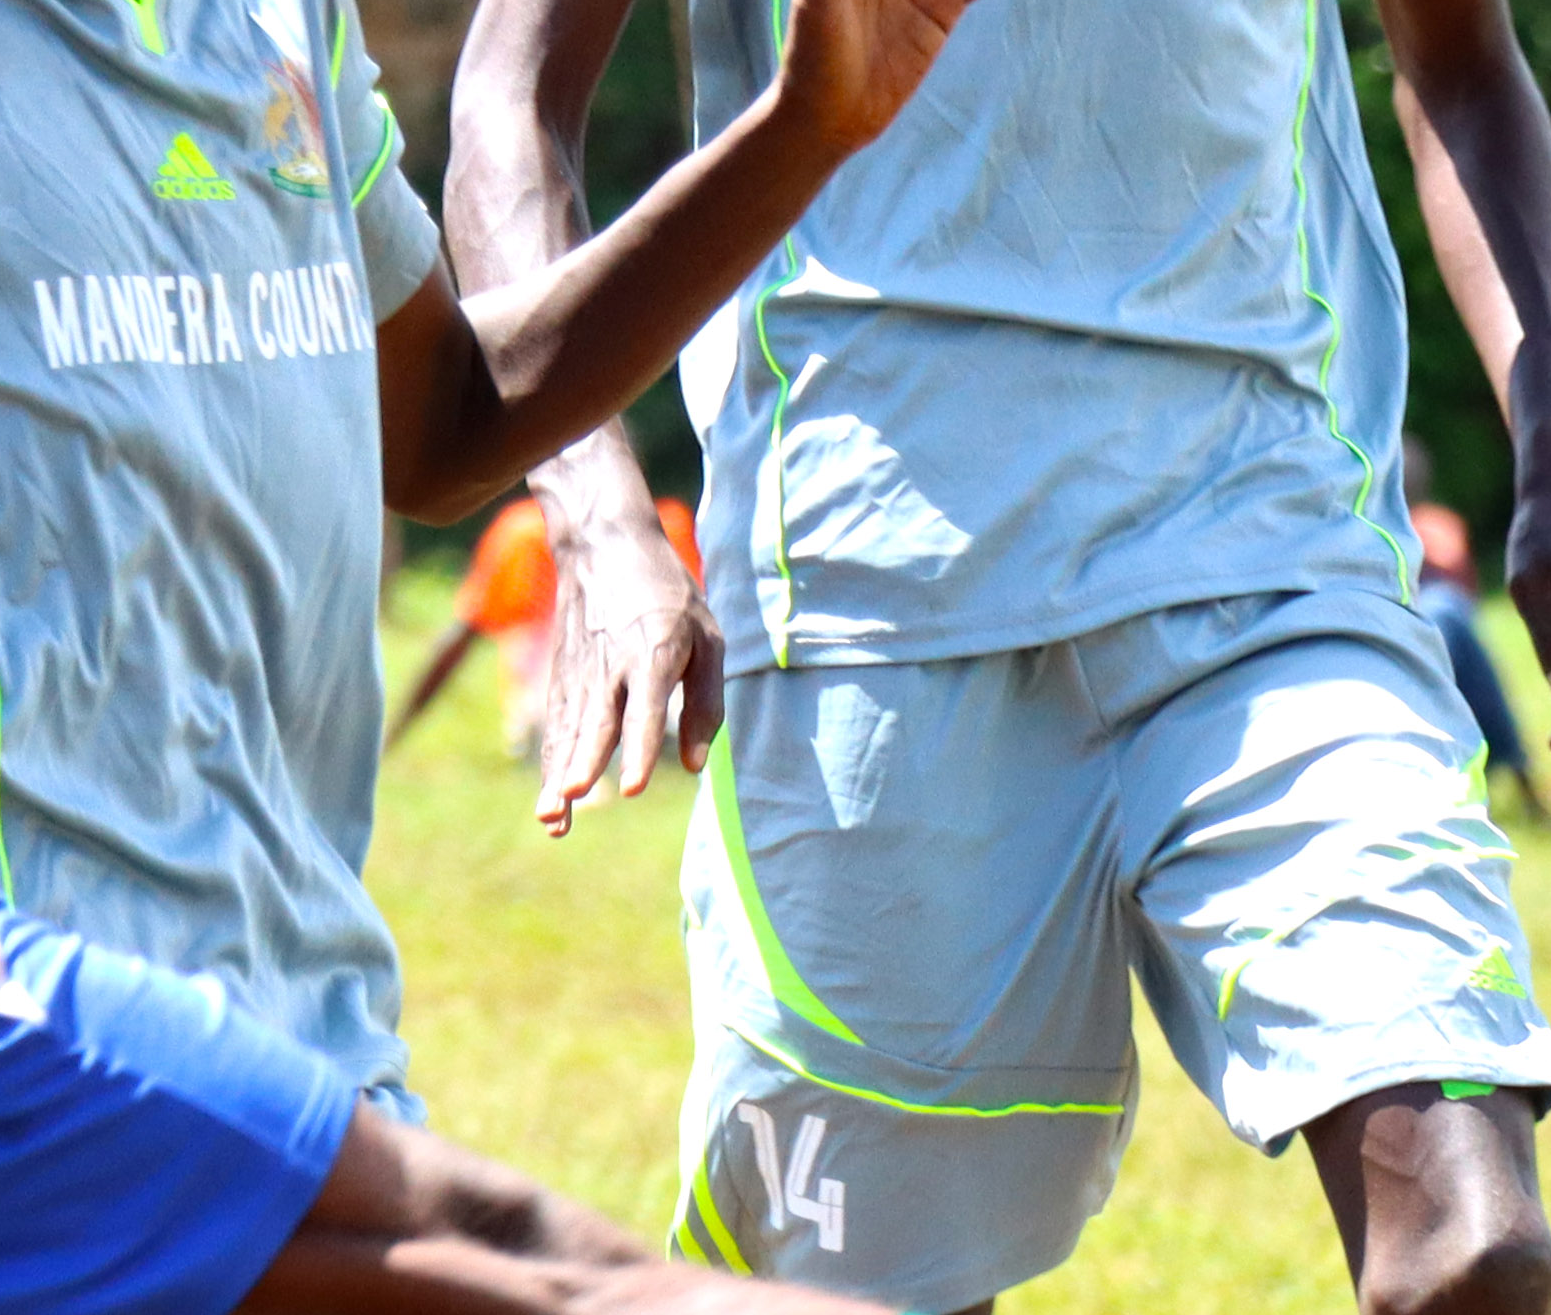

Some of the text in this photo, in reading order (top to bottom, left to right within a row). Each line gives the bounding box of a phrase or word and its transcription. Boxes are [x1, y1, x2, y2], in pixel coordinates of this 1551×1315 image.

[153, 179, 236, 201] adidas
[33, 272, 244, 369] MANDERA
[737, 1102, 846, 1253] 14
